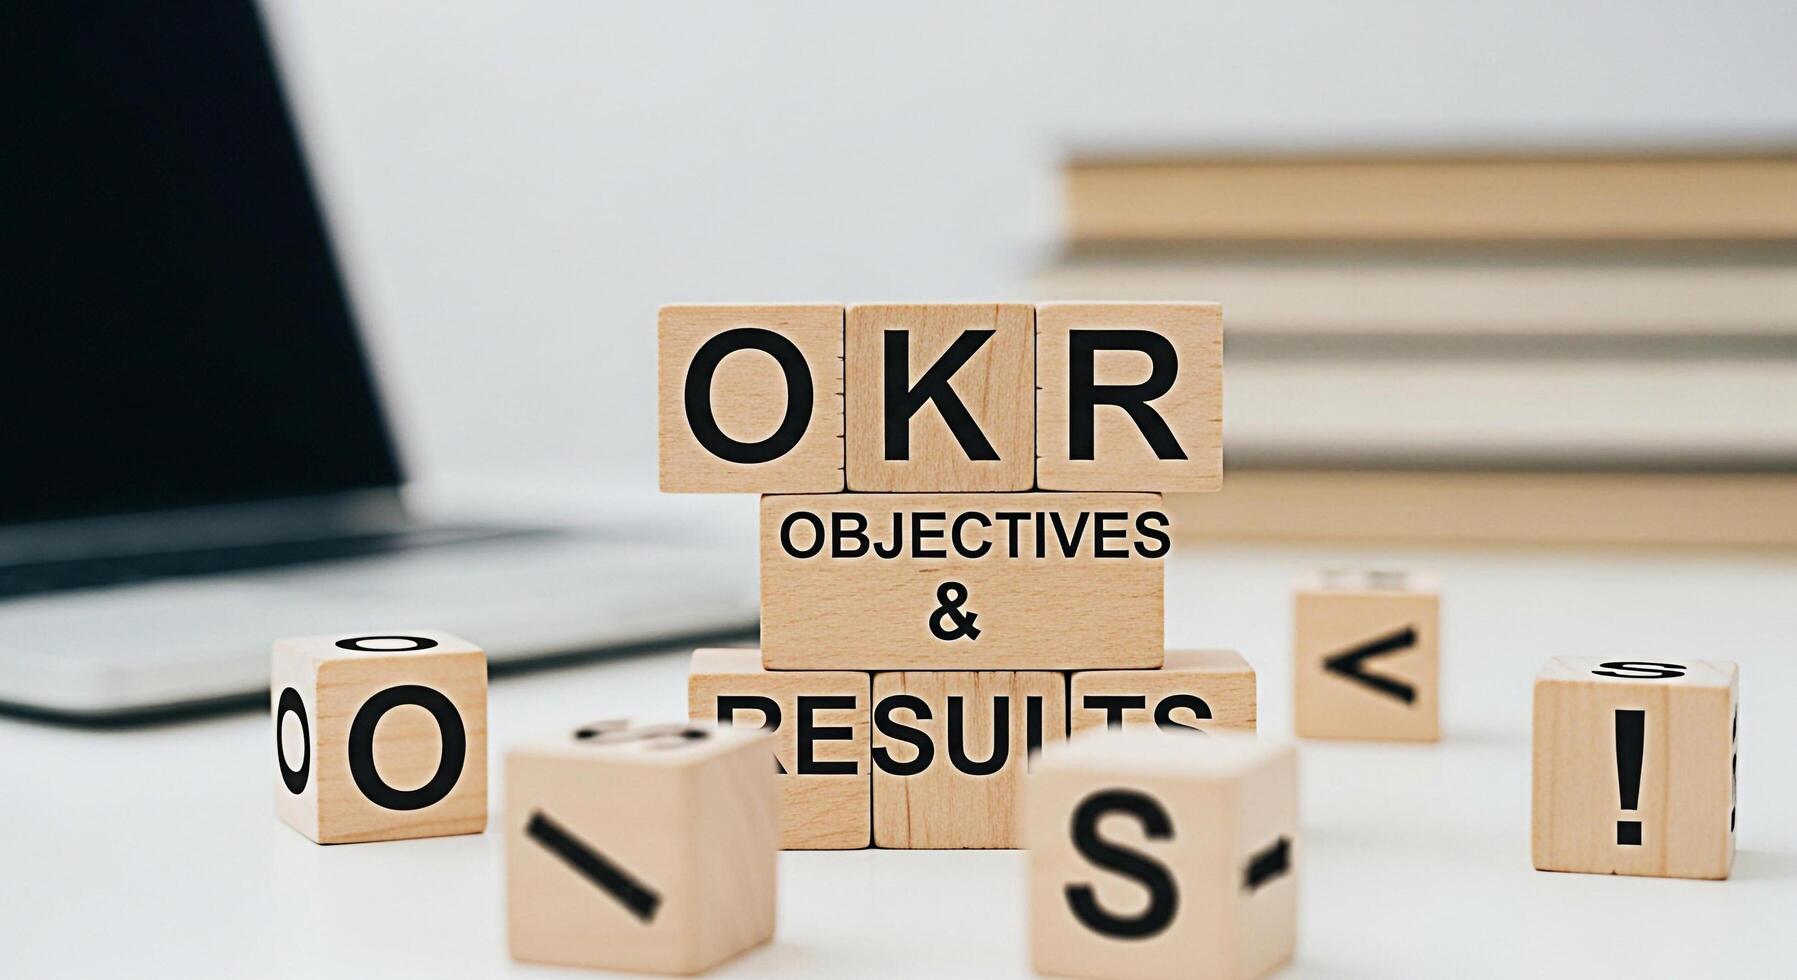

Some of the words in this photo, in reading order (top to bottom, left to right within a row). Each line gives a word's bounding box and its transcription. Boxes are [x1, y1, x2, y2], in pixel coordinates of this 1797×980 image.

[780, 511, 1171, 559] OBJECTIVES
[928, 581, 982, 641] &
[348, 684, 467, 811] O
[1614, 709, 1646, 846] !
[1063, 787, 1180, 942] S
